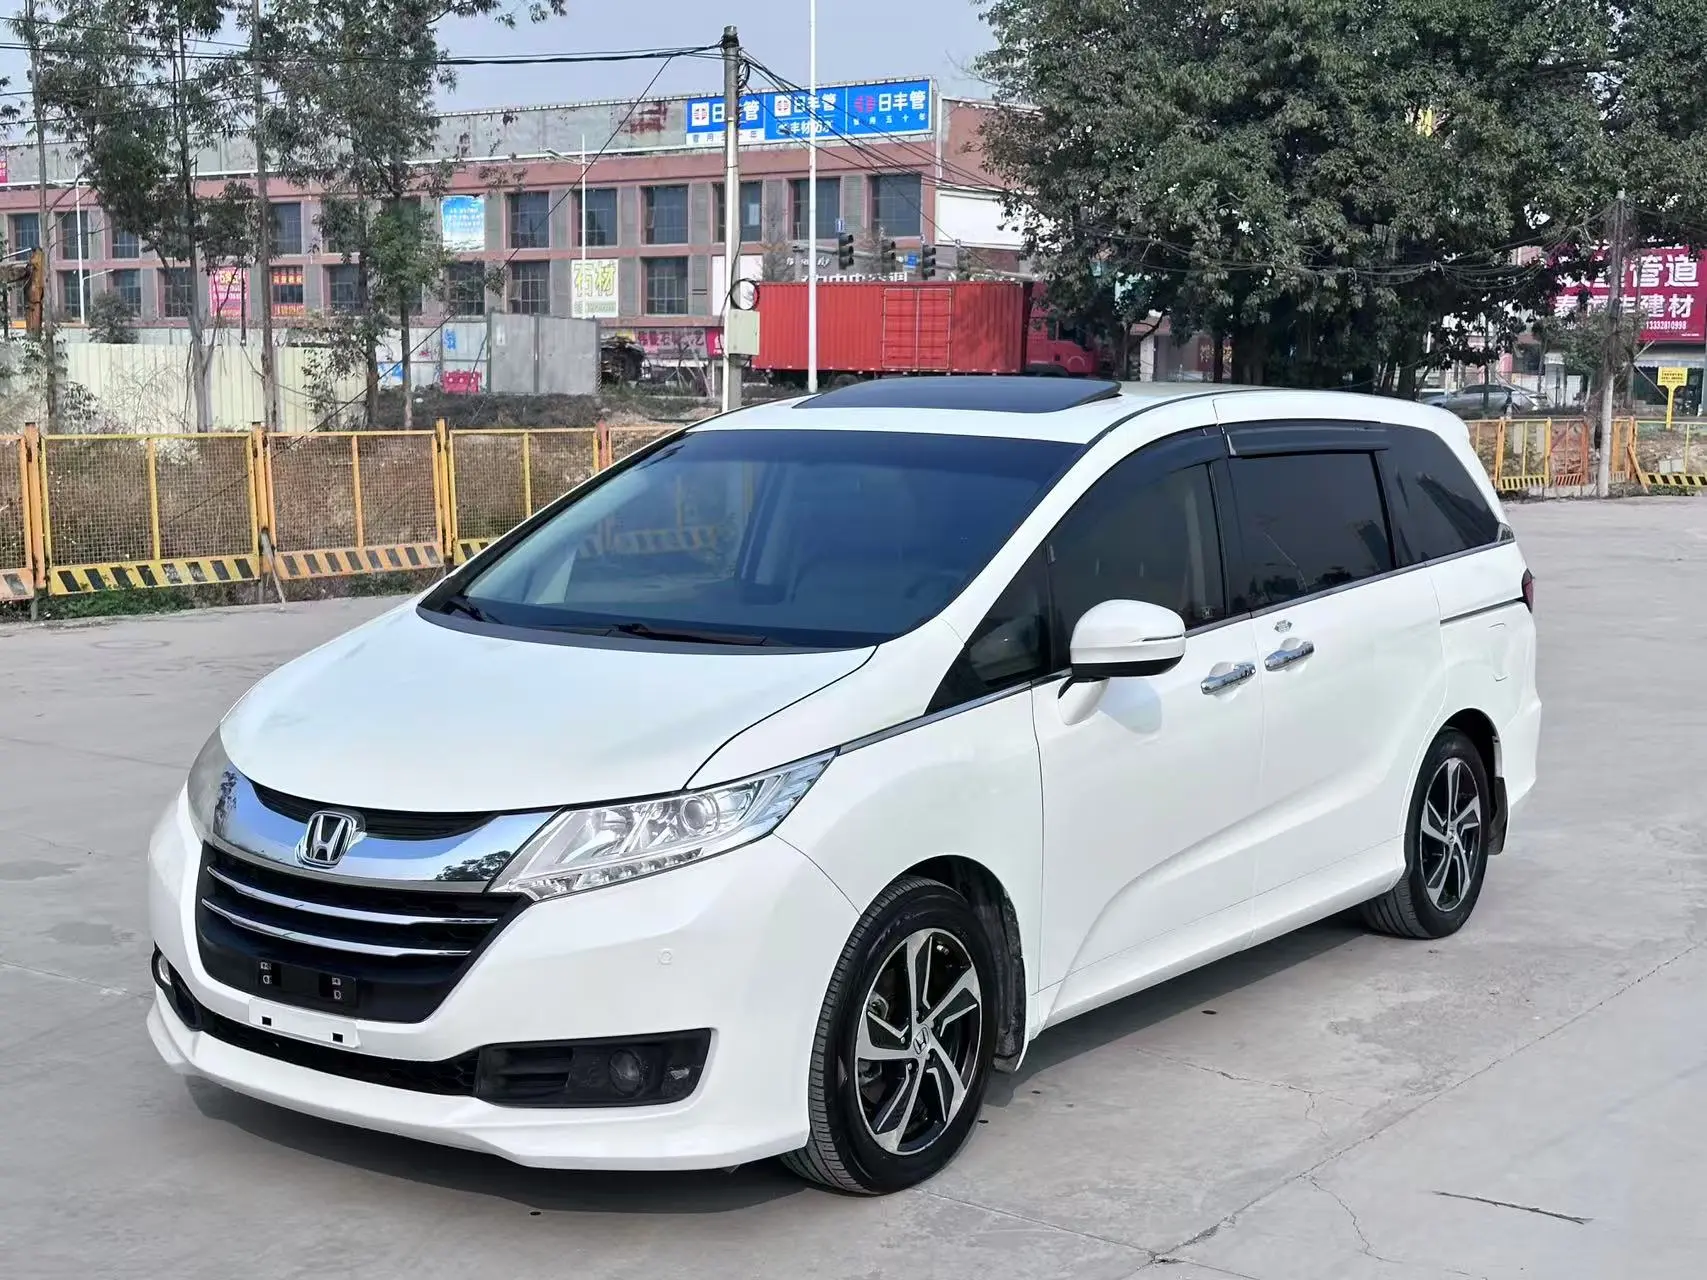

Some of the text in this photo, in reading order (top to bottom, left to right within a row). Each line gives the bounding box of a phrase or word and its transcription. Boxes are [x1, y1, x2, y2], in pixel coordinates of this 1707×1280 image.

[712, 99, 760, 123] 日管
[879, 90, 926, 112] 日丰管
[574, 261, 616, 298] 石材
